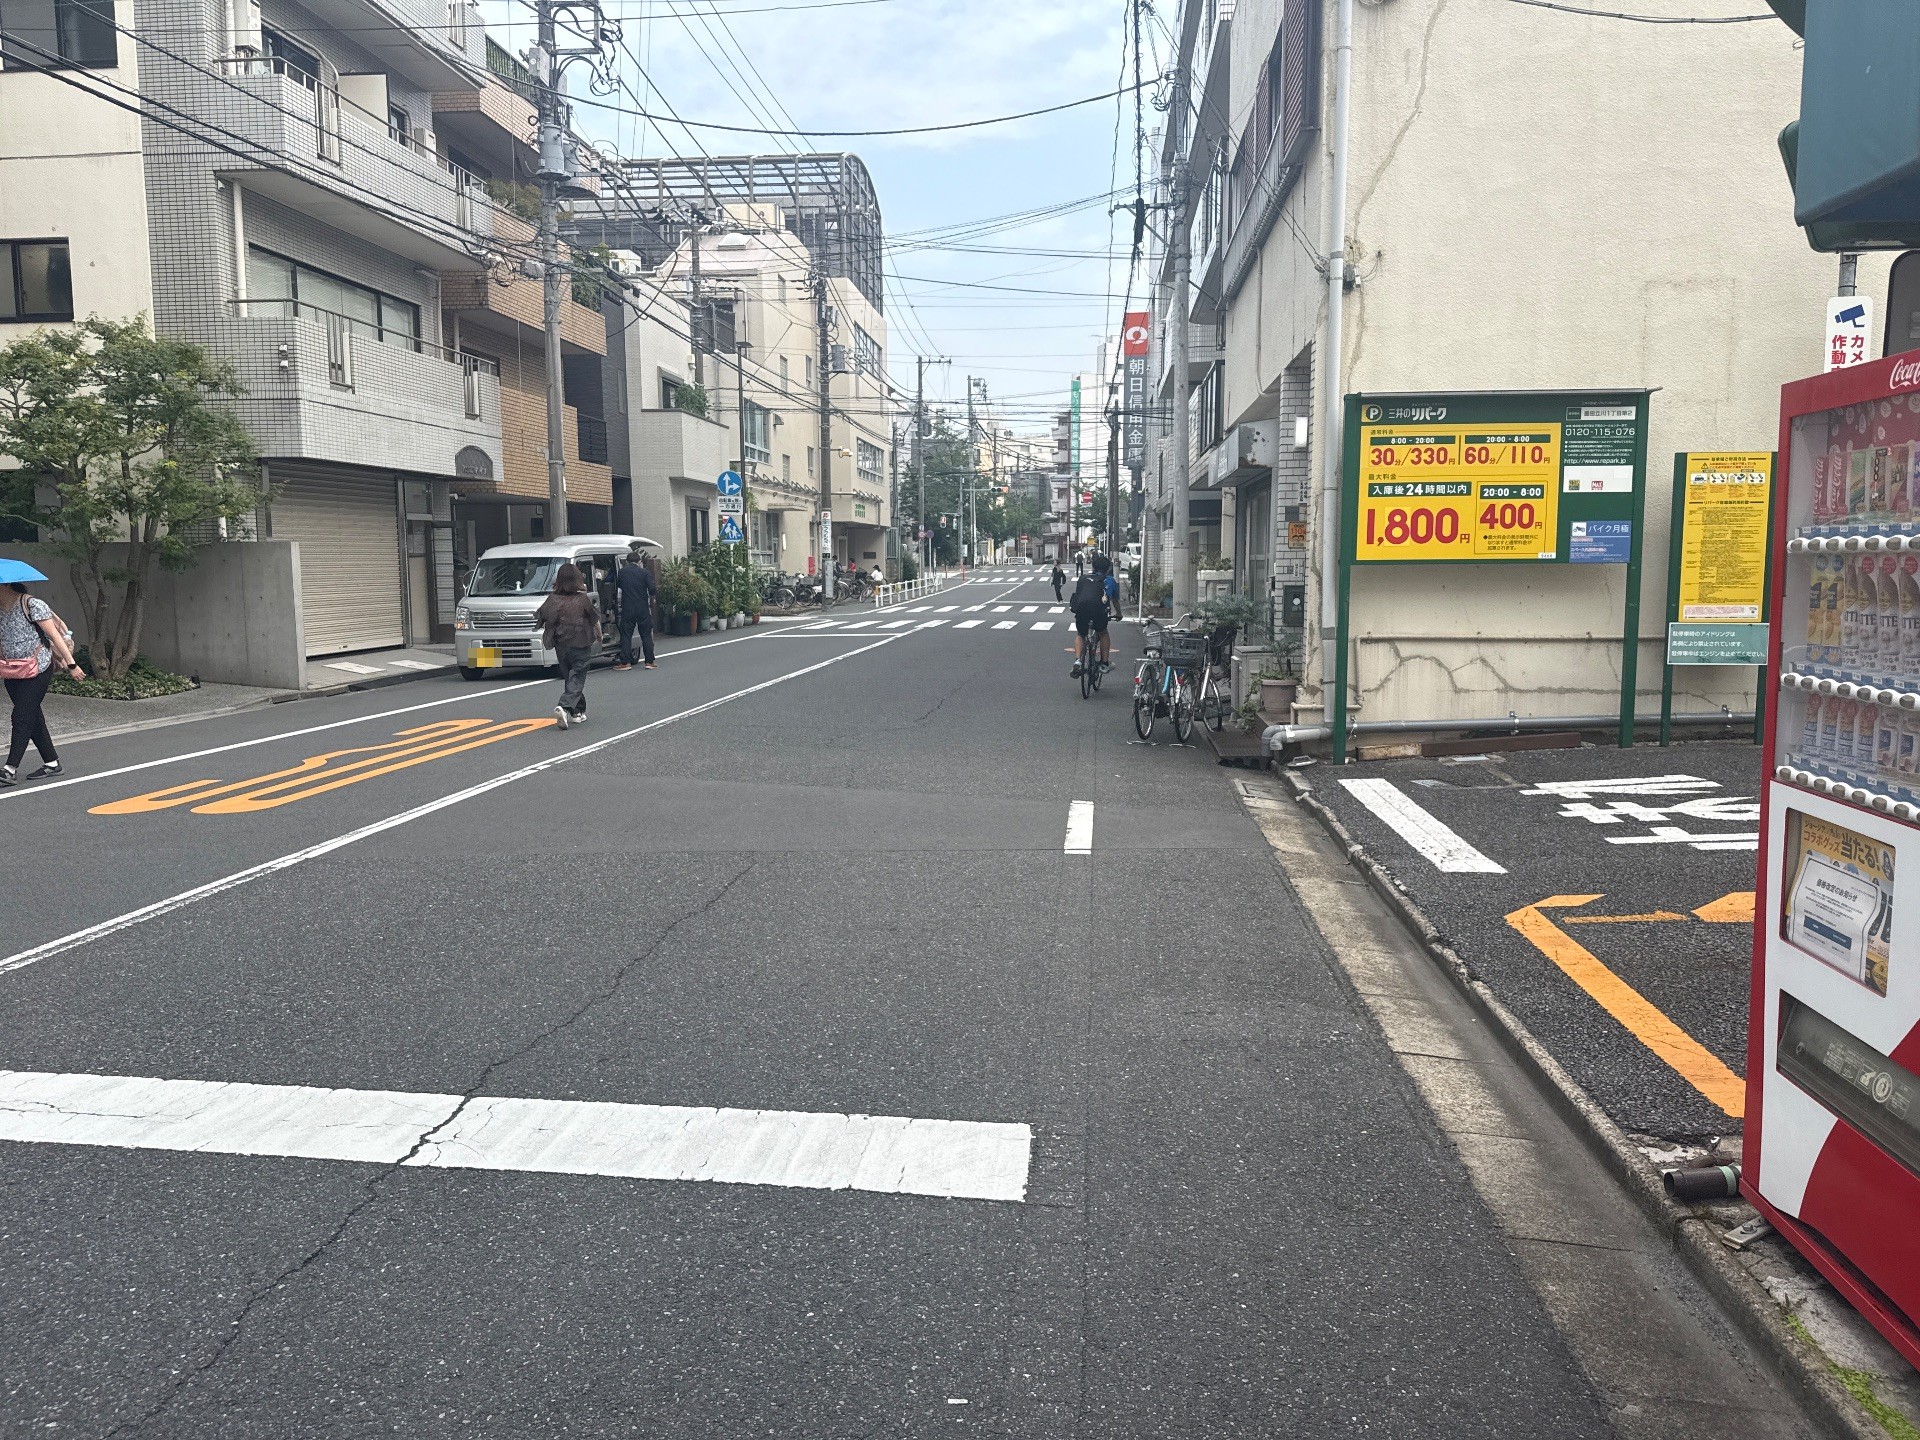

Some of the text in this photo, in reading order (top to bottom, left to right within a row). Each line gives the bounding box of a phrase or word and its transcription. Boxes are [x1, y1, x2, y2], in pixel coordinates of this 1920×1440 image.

[1128, 358, 1144, 462] 朝日信用金庫
[1388, 407, 1447, 421] 三井のリパーク
[1370, 446, 1456, 466] 30分/330円
[1464, 445, 1551, 465] 60分/110円
[1563, 457, 1627, 465] http://www.repark.jp
[1372, 483, 1467, 496] 入庫後24時間以内
[1483, 488, 1510, 497] 20:00
[1520, 487, 1542, 496] 8:00
[1480, 503, 1543, 530] 400円
[1366, 507, 1471, 547] 1,800円
[1588, 524, 1630, 533] バイク月極
[1804, 820, 1826, 833] ジョージア
[1803, 830, 1841, 853] コラボグッズ
[1816, 878, 1858, 902] 価格改定のお知らせ
